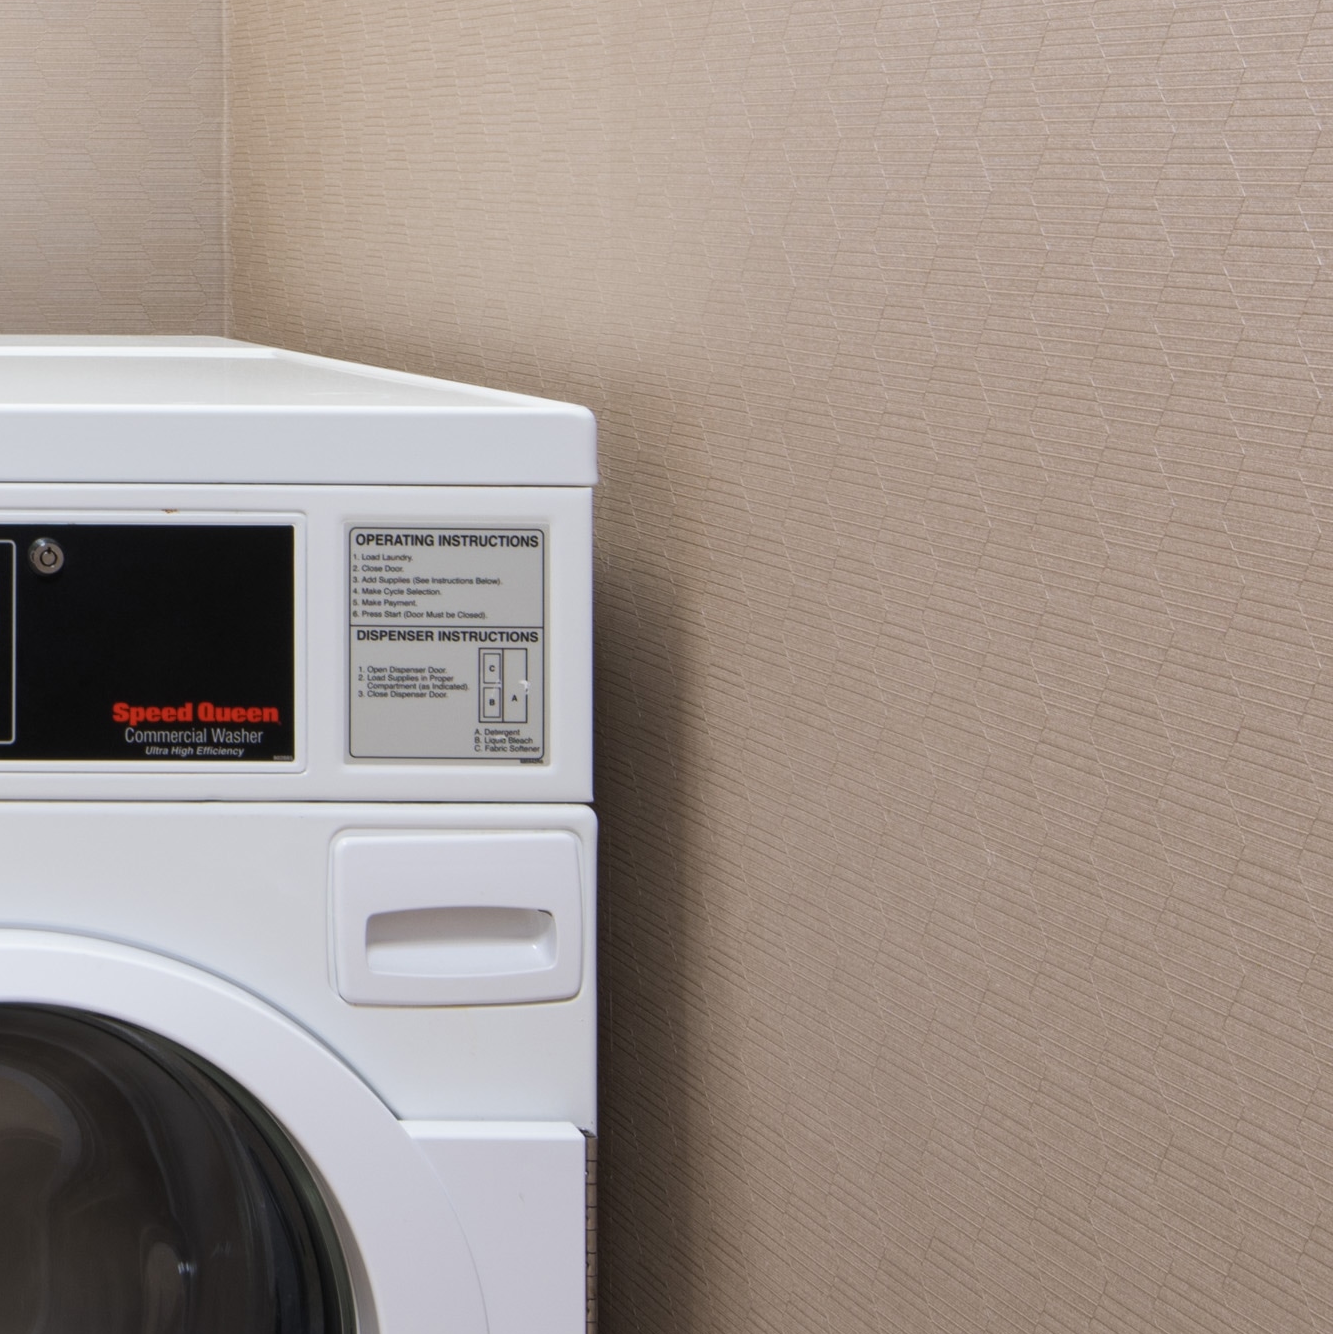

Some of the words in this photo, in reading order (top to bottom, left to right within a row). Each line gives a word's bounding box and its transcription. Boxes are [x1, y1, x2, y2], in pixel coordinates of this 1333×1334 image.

[355, 533, 434, 547] OPERATING
[438, 534, 539, 548] INSTRUCTIONS
[382, 554, 413, 562] Laundry.
[361, 564, 383, 572] Close
[384, 565, 403, 573] Door.
[361, 576, 377, 584] Add
[378, 576, 411, 585] Supplies
[412, 576, 430, 585] (See
[431, 577, 474, 585] Instructions
[475, 577, 502, 586] Below).
[361, 587, 382, 595] Make
[383, 587, 405, 596] Cycle
[383, 599, 417, 608] Payment.
[361, 610, 382, 618] Press
[384, 610, 402, 618] Start
[403, 610, 424, 619] (Door
[426, 611, 444, 619] Must
[445, 611, 456, 619] be
[457, 611, 487, 620] Closed).
[357, 630, 434, 642] DISPENSER
[438, 631, 539, 643] INSTRUCTIONS
[367, 665, 388, 675] Open
[388, 666, 426, 675] Dispenser
[367, 674, 386, 683] Load
[387, 674, 419, 683] Supplies
[429, 674, 454, 683] Proper
[367, 683, 416, 691] Compartment
[418, 683, 430, 691] (as
[432, 682, 468, 691] Indicated).
[367, 690, 388, 698] Close
[390, 690, 427, 699] Dispenser
[112, 702, 193, 726] Speed
[198, 702, 279, 722] Queen
[125, 727, 207, 743] Commercial
[211, 728, 264, 743] Washer
[485, 729, 520, 738] Detergent
[484, 736, 506, 746] Liquid
[508, 736, 533, 744] Bleach
[145, 746, 169, 755] Ultra
[171, 746, 194, 757] High
[196, 746, 244, 757] Efficiency
[485, 744, 507, 752] Fabric
[509, 744, 540, 752] Softener
